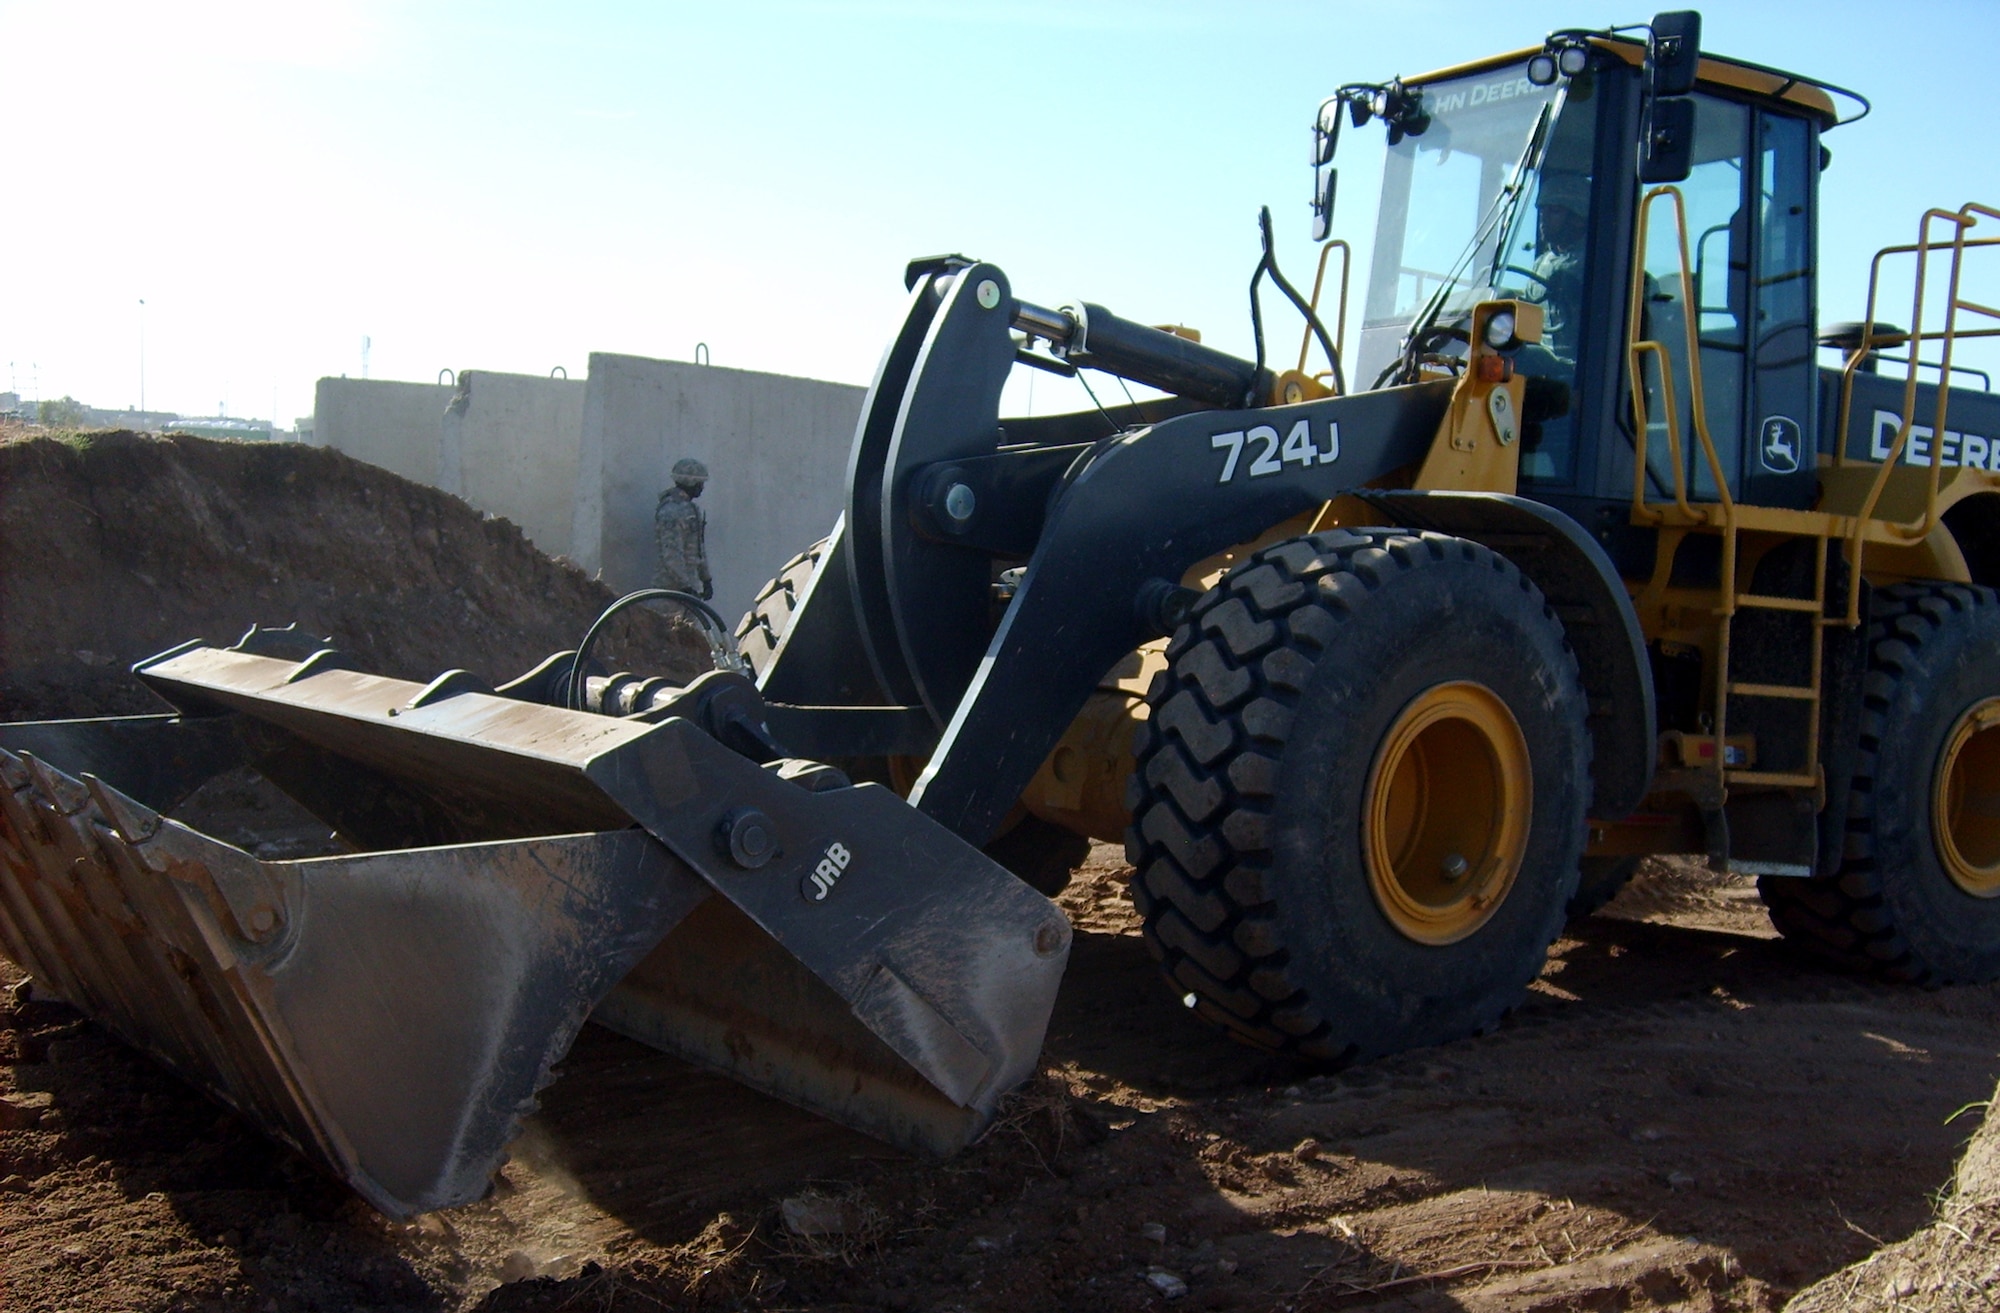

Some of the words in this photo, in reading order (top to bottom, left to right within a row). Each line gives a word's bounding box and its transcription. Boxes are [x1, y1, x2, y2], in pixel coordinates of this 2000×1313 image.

[1434, 91, 1467, 114] HN
[1211, 419, 1340, 483] 724J
[809, 842, 851, 901] JRB
